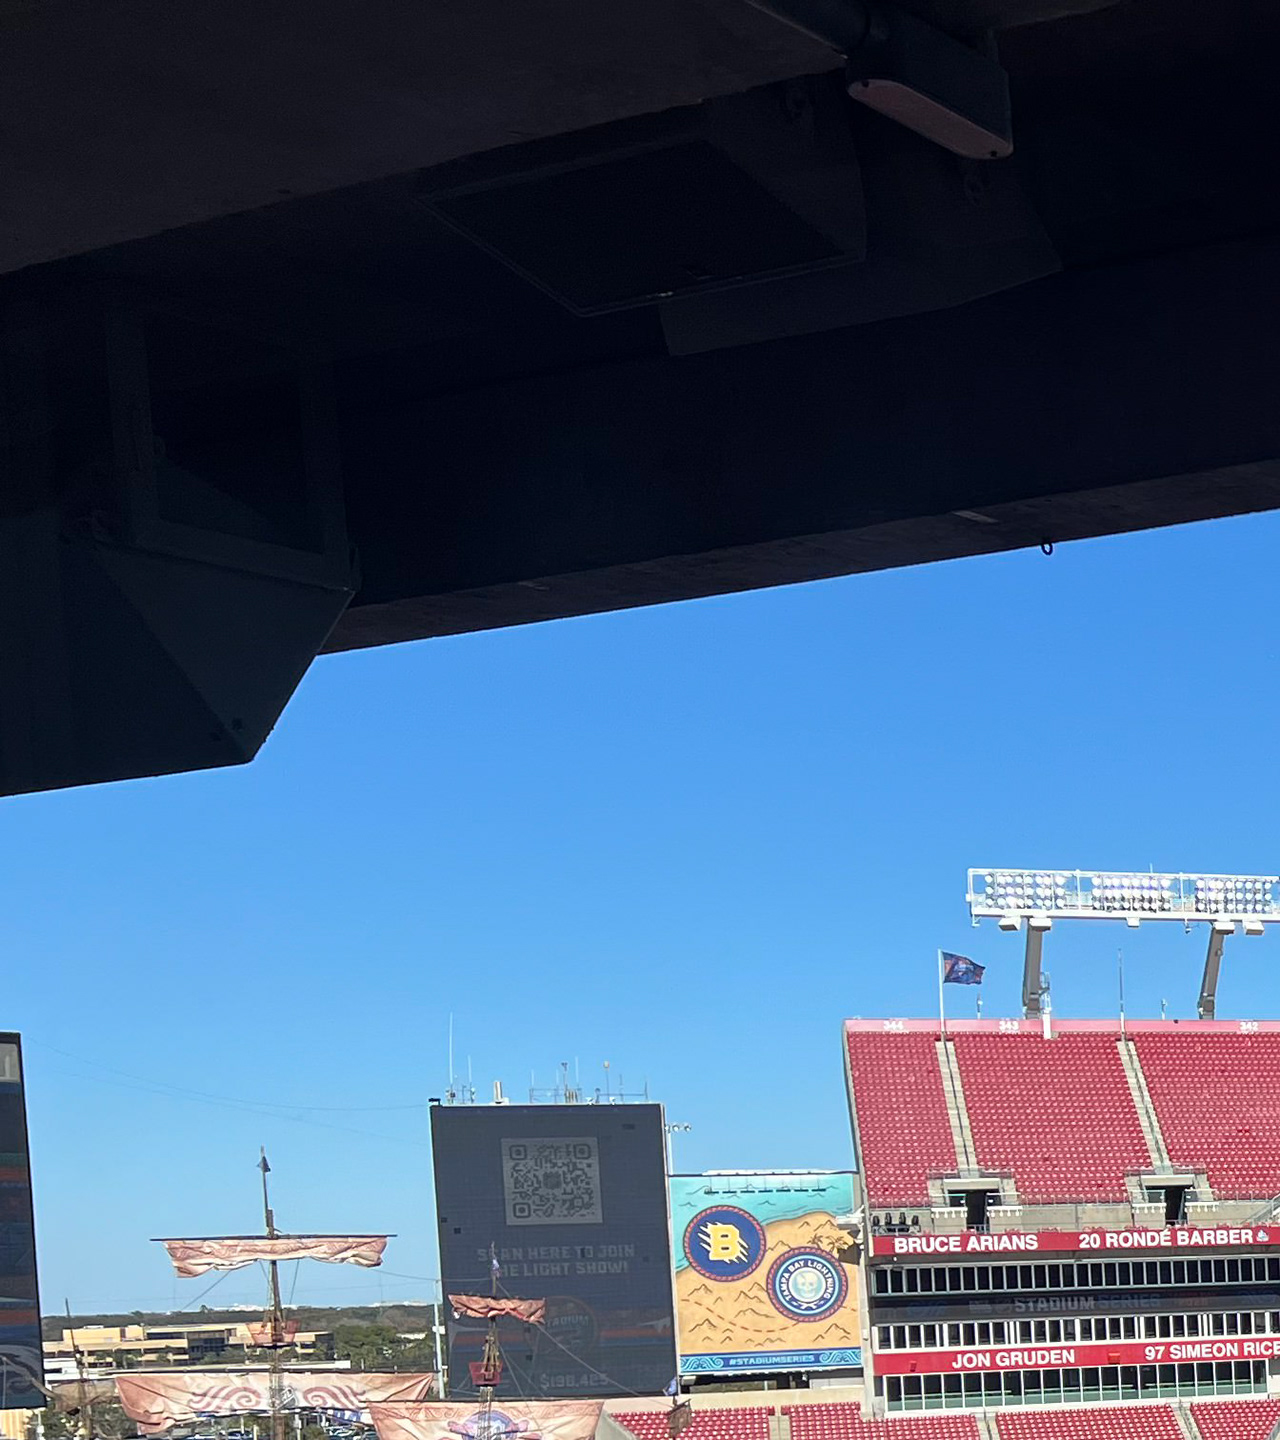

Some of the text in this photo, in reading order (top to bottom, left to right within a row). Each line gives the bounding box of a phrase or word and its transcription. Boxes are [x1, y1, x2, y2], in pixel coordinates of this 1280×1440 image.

[894, 1234, 1038, 1253] BRUCE ARIANS
[1079, 1229, 1252, 1248] 20 RONDÉ BARBER
[477, 1244, 635, 1262] SAN HERE TO JOIN
[524, 1262, 570, 1277] LIGHT
[952, 1349, 1075, 1370] JON GRUDEN
[1145, 1346, 1165, 1360] 97
[1169, 1343, 1238, 1359] SIMEON
